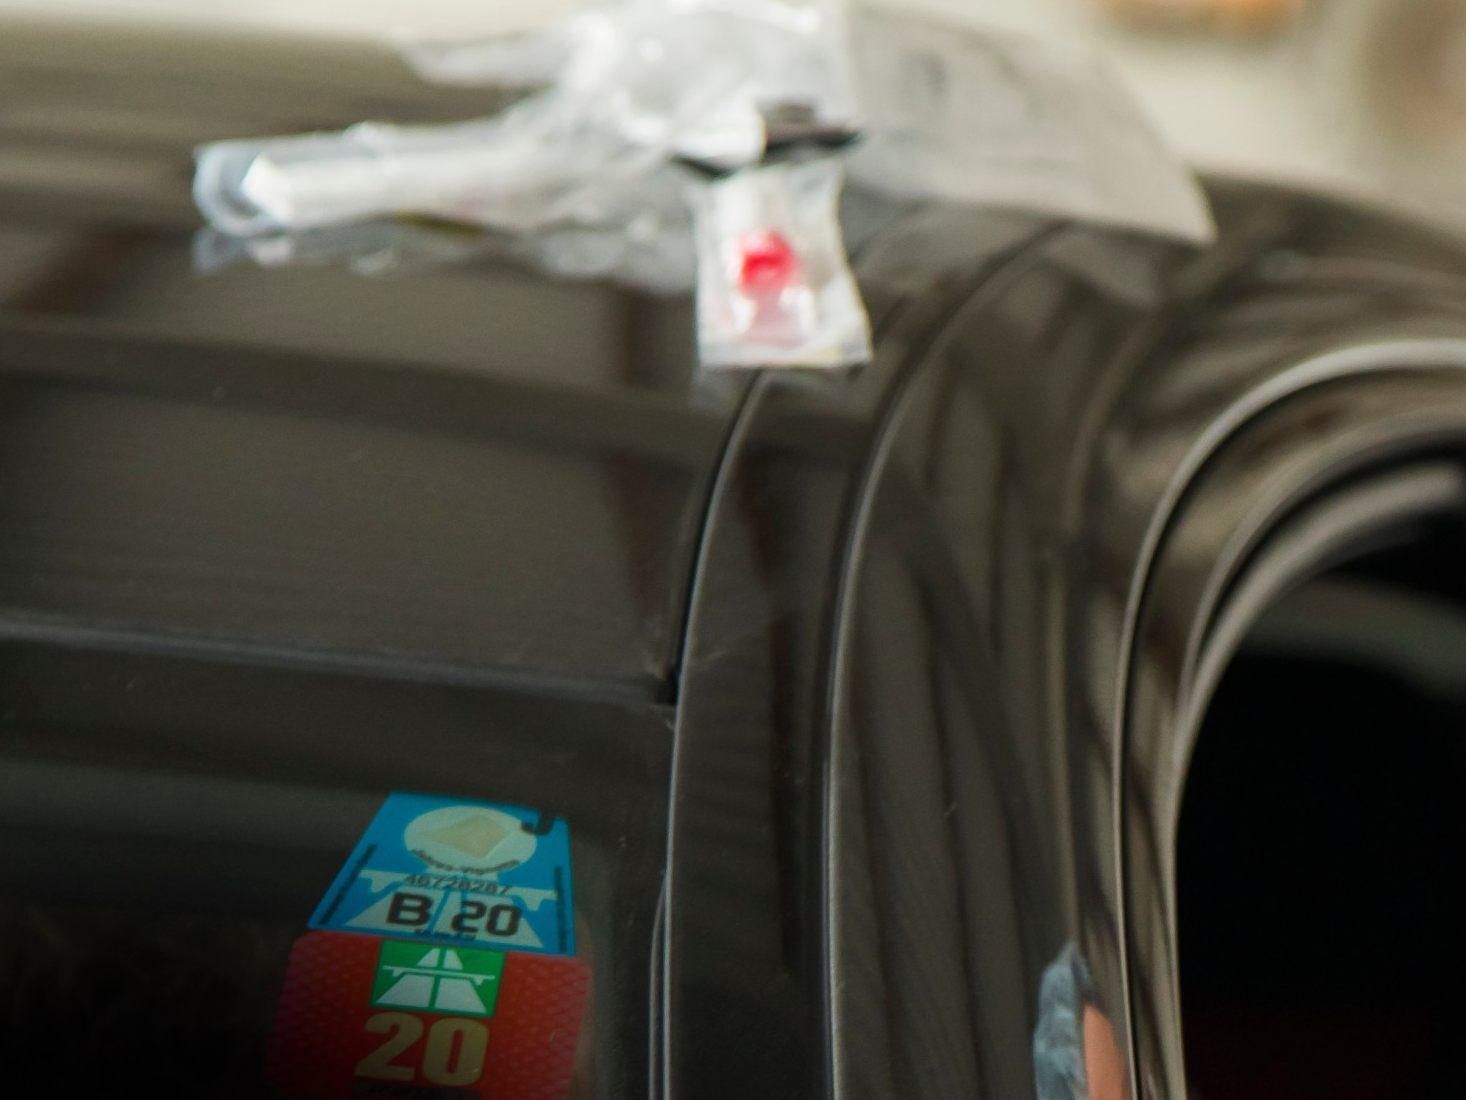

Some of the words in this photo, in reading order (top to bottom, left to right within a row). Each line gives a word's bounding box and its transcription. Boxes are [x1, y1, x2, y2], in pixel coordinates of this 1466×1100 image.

[386, 892, 433, 927] B
[450, 899, 522, 938] 20
[354, 1011, 490, 1086] 20
